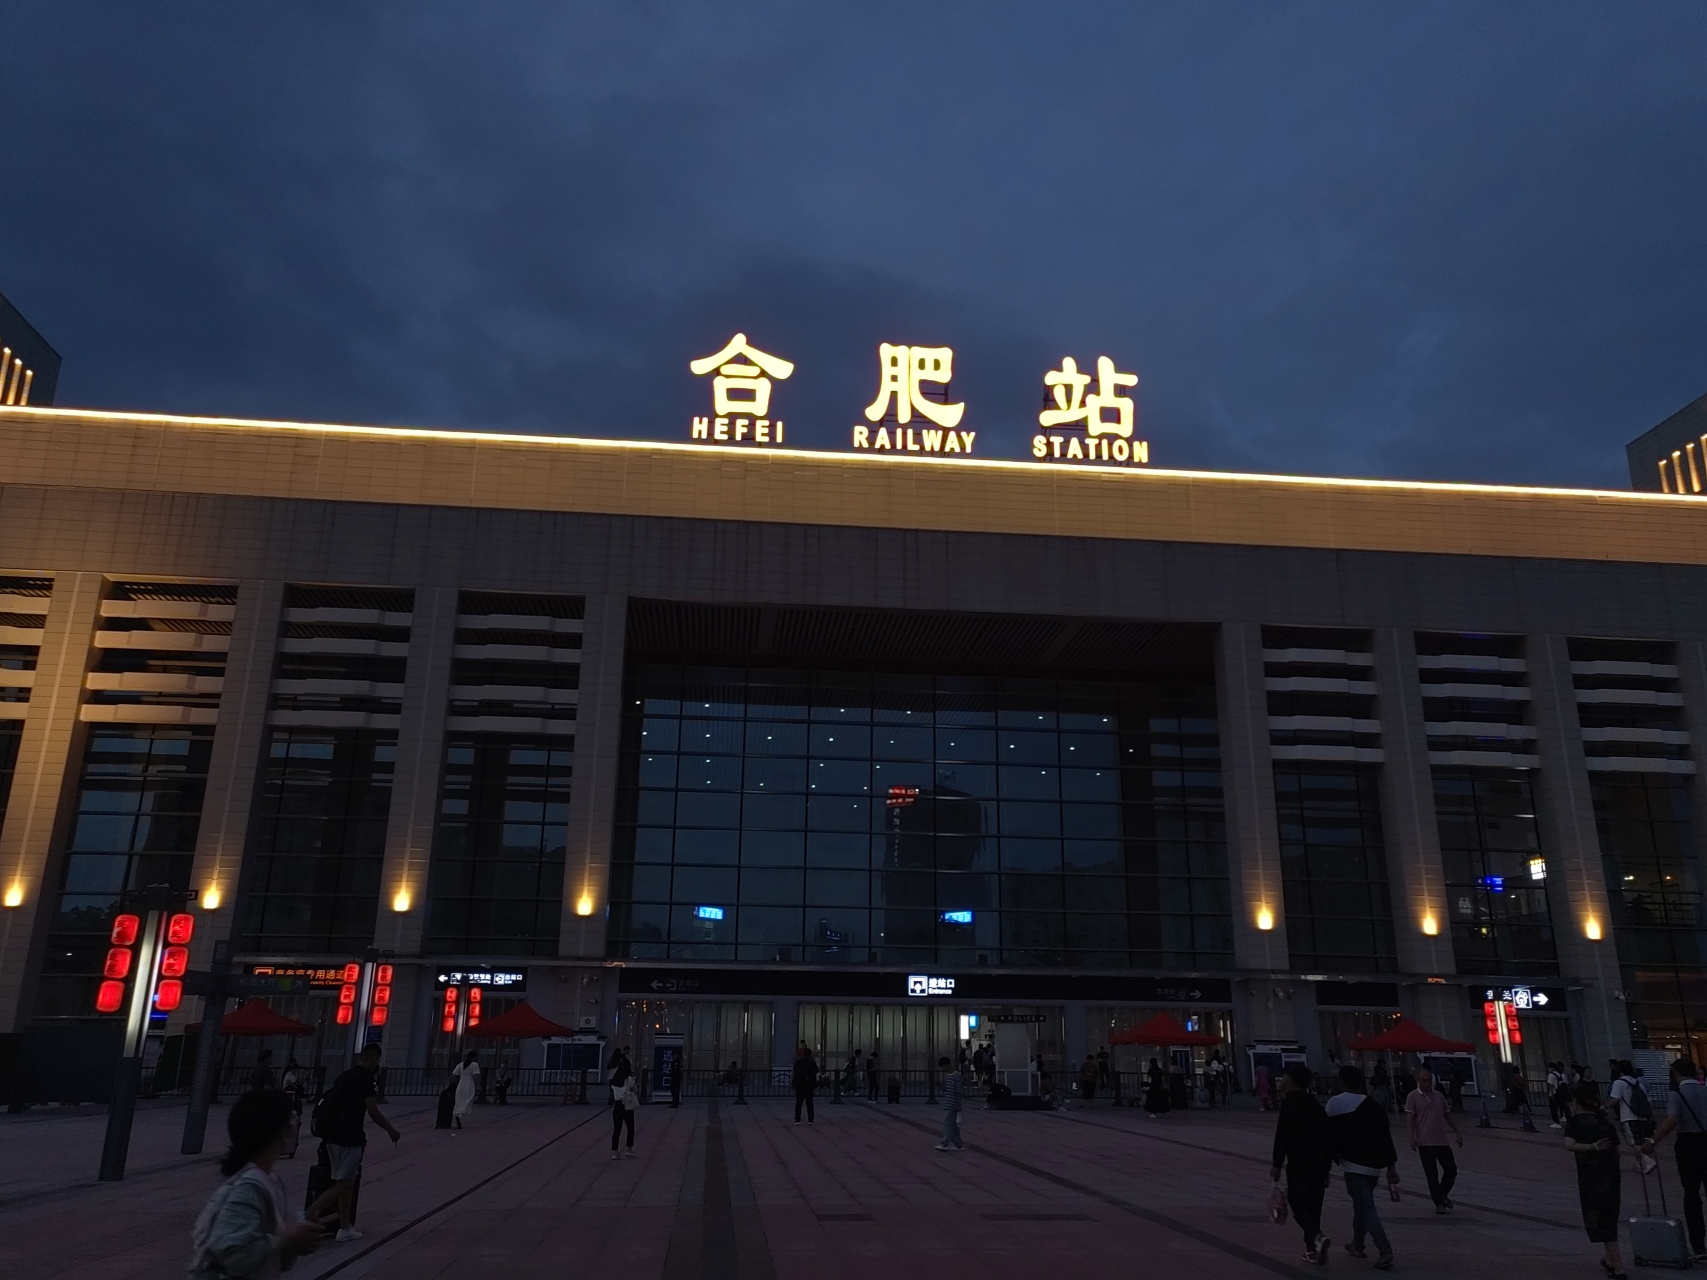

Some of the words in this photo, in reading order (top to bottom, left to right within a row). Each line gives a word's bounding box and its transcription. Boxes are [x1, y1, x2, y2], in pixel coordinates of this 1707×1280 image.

[692, 416, 784, 444] HEFEI
[853, 425, 976, 454] RAILWAY
[1032, 434, 1149, 464] STATION
[929, 977, 955, 988] 进站口
